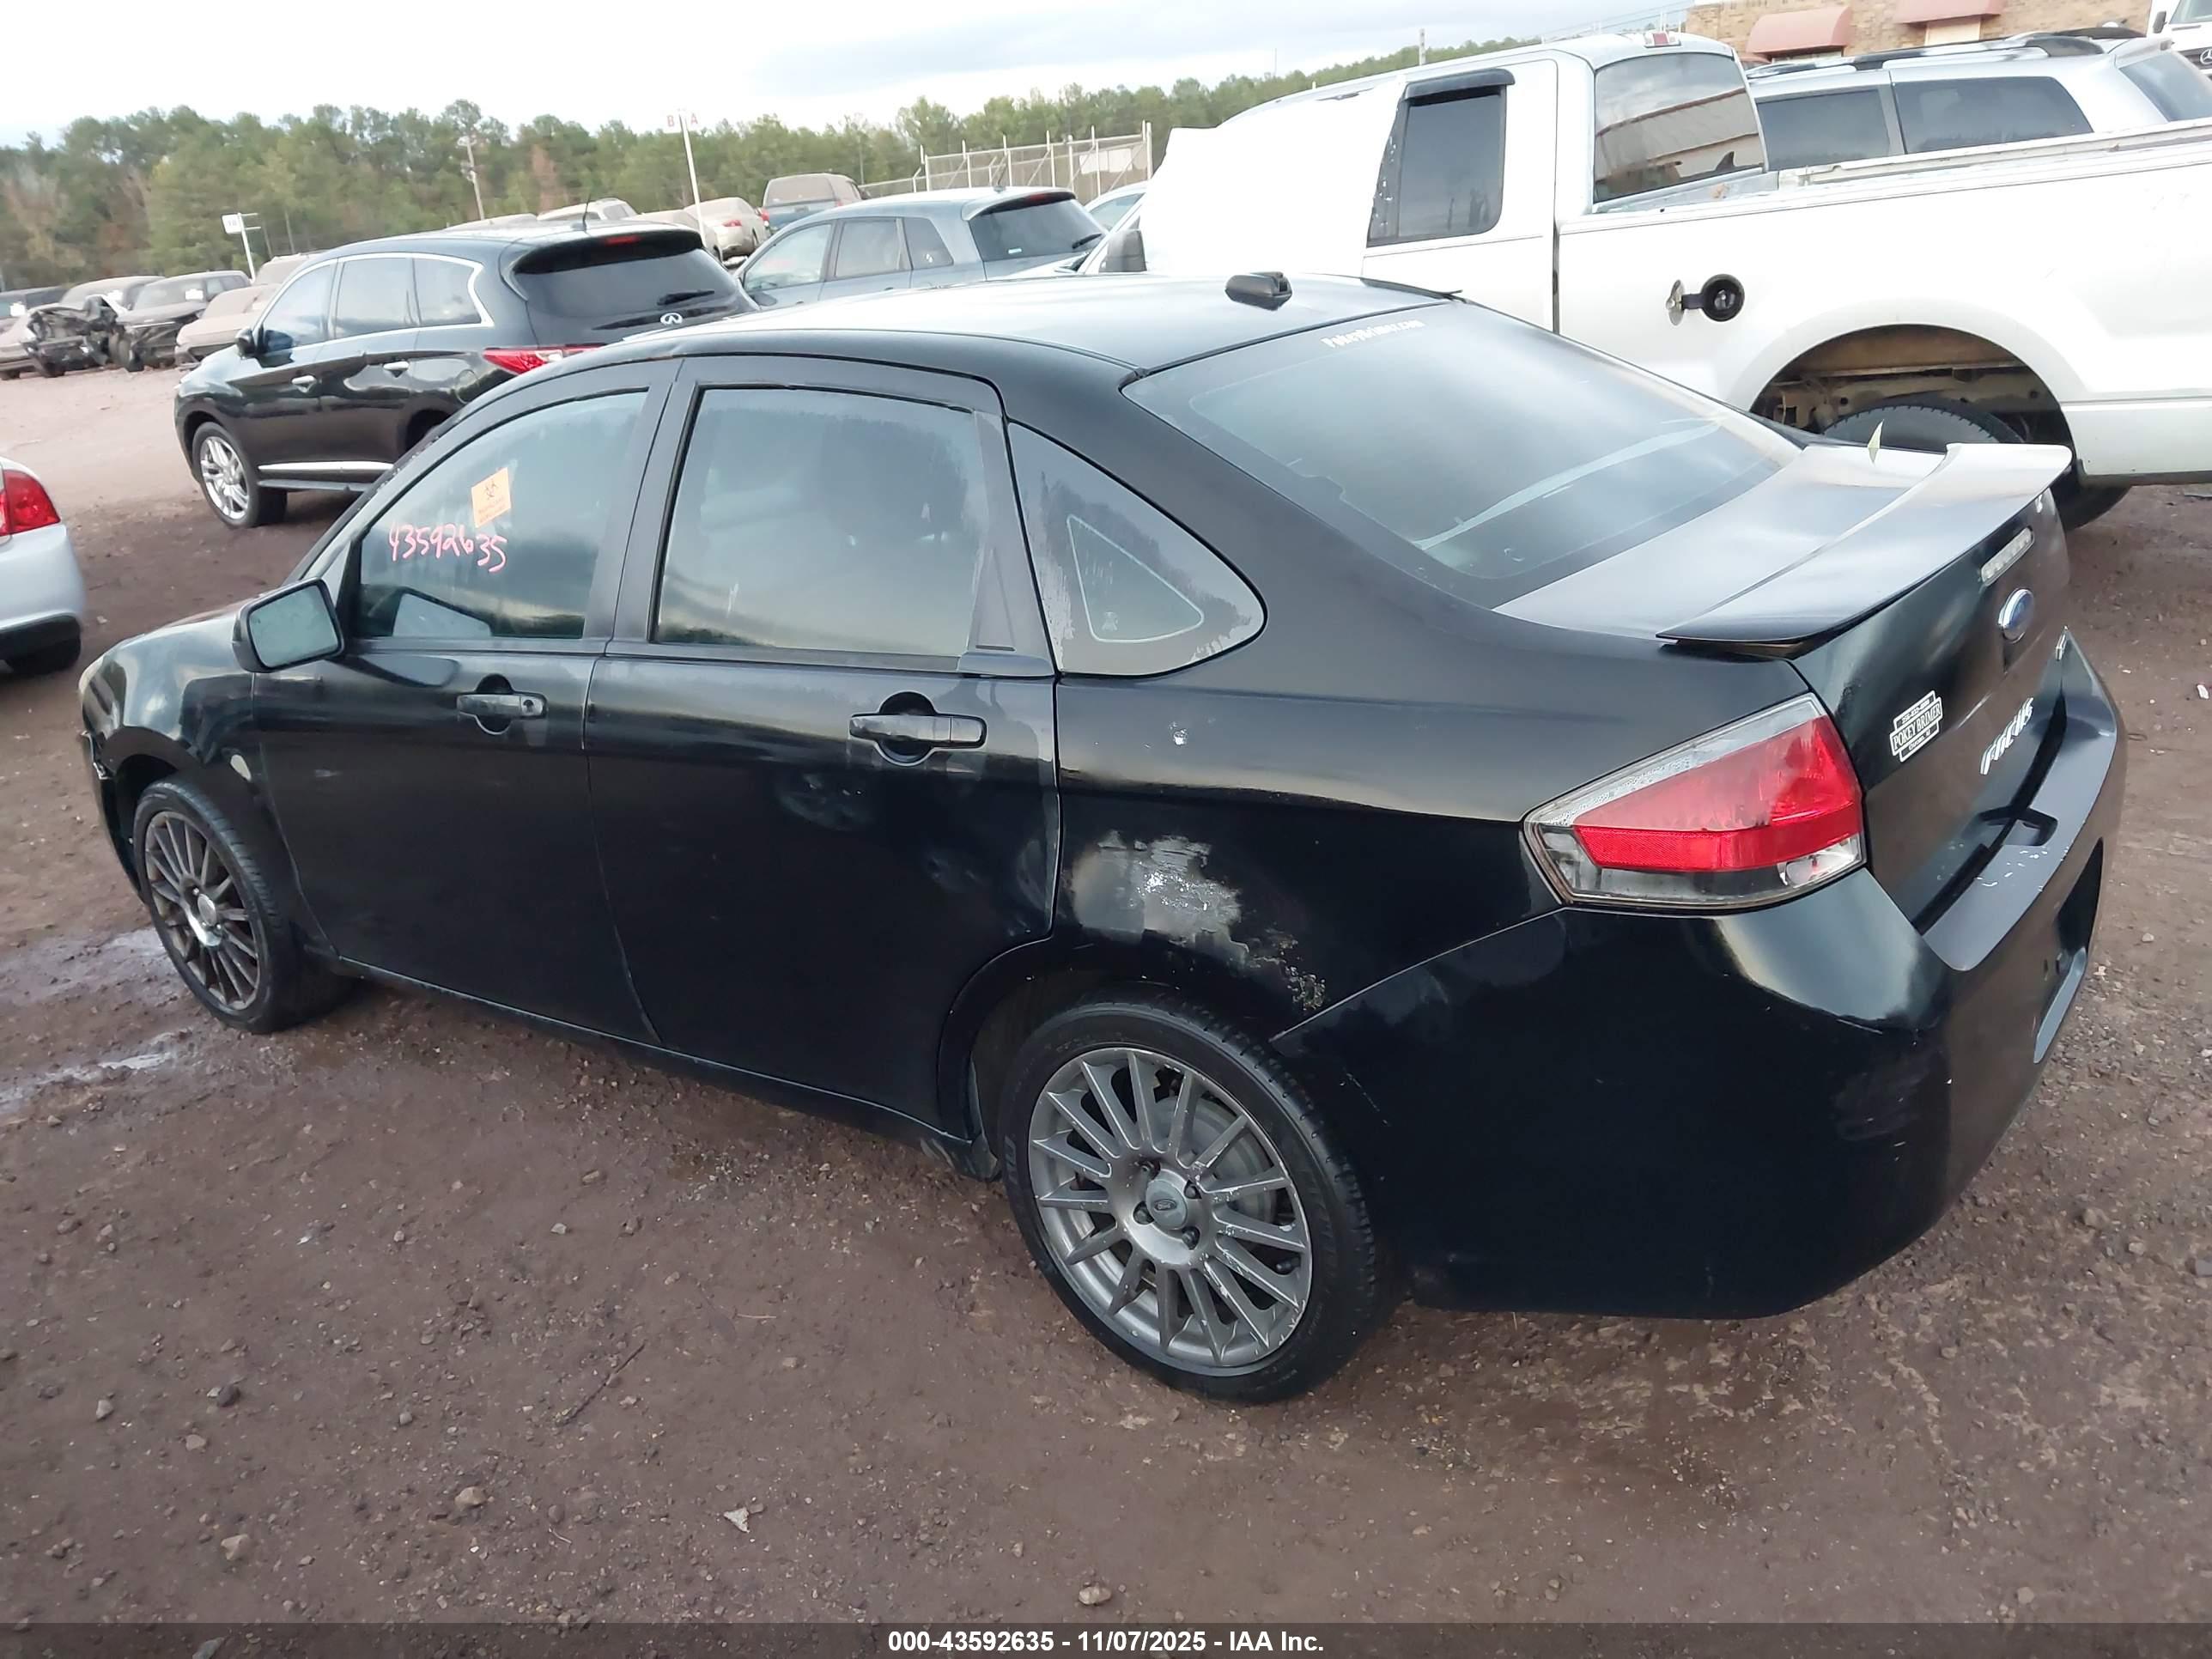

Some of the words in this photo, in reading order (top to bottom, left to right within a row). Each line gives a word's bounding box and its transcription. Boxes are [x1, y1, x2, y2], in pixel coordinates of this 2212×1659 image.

[690, 112, 698, 125] A
[389, 522, 507, 573] 43592635
[1893, 721, 1917, 750] POKEY
[1917, 702, 1941, 732] BRIMER
